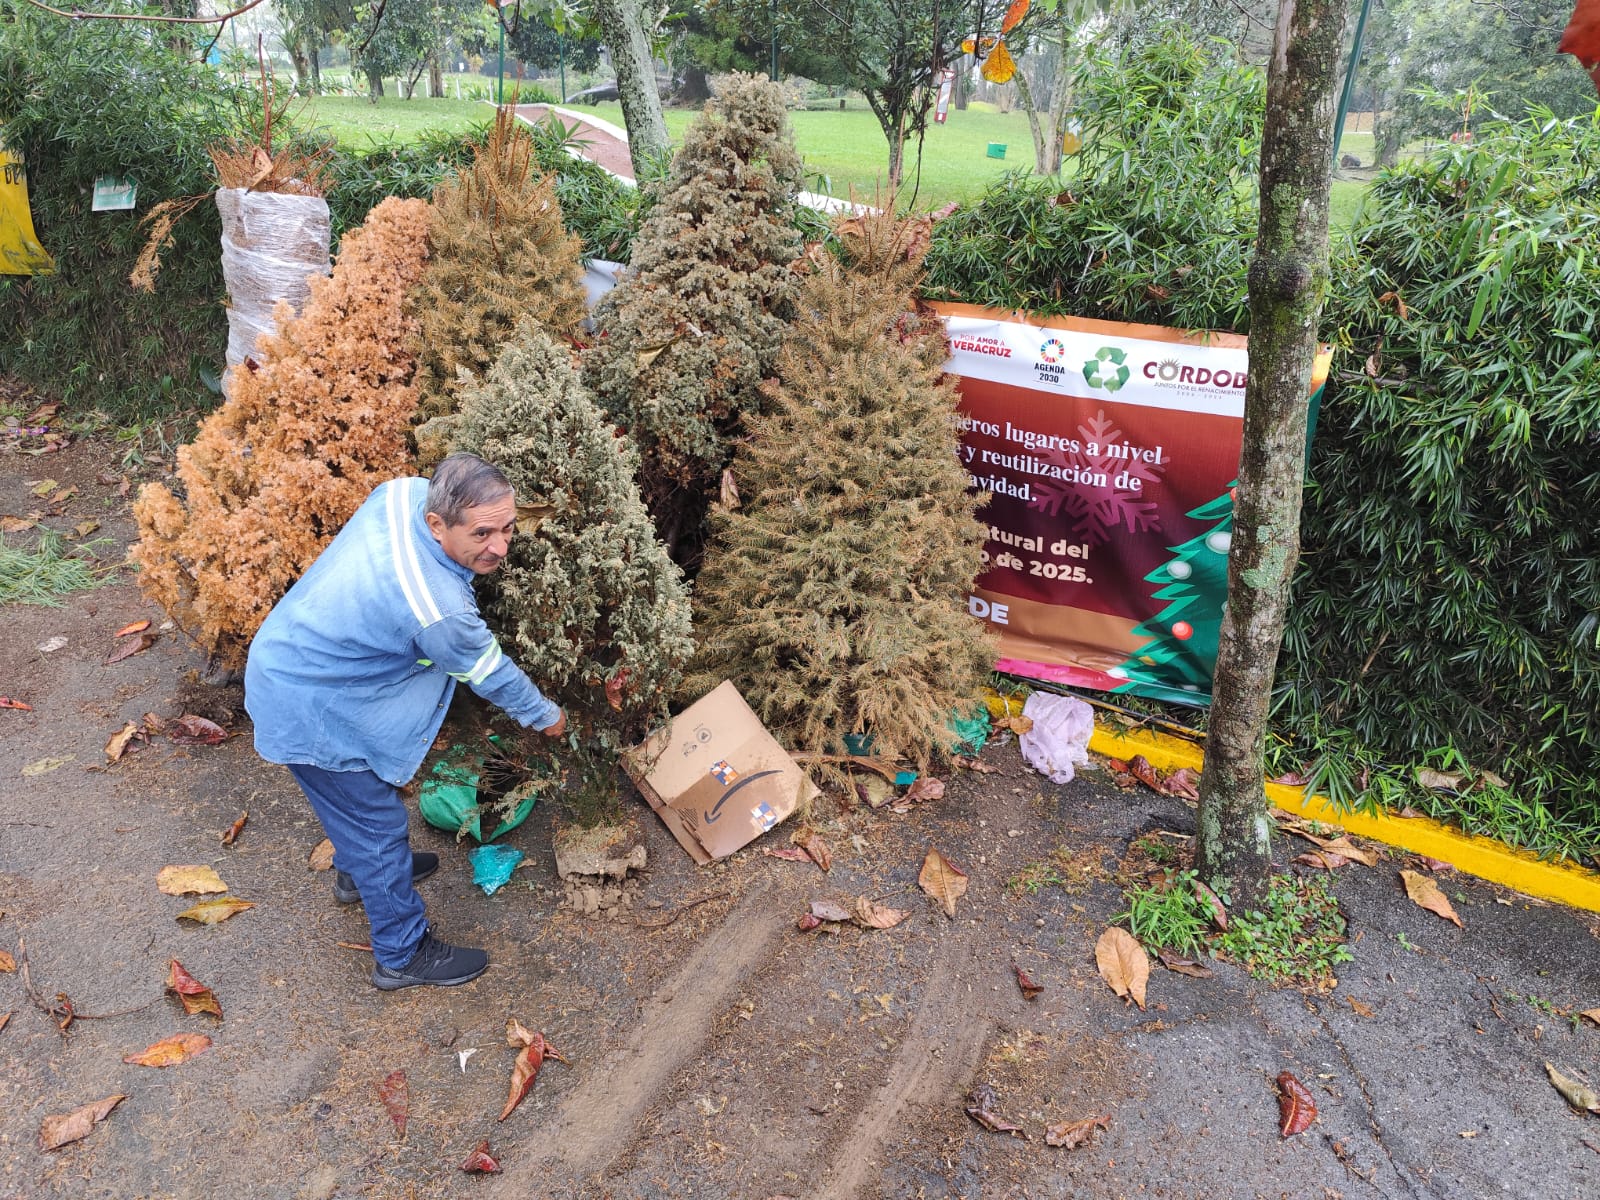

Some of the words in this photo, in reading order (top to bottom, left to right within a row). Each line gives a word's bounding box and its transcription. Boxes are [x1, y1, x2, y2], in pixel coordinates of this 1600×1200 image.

[953, 339, 1012, 359] VERACRUZ
[960, 334, 975, 342] POR
[977, 336, 998, 346] AMOR
[1034, 362, 1065, 375] AGENDA
[1039, 372, 1059, 384] 2030
[1143, 359, 1248, 389] CORDOB
[1154, 381, 1177, 390] JUNTOS
[1198, 386, 1245, 397] RENACIMIENTO
[1005, 421, 1080, 454] lugares
[1086, 441, 1100, 457] a
[1107, 440, 1163, 465] nivel
[965, 445, 976, 463] y
[981, 449, 1107, 488] reutilización
[1114, 468, 1142, 492] de
[969, 474, 1037, 502] avidad.
[1050, 538, 1089, 560] del
[996, 551, 1024, 571] de
[1029, 560, 1094, 584] 2025.
[968, 595, 1009, 625] DE
